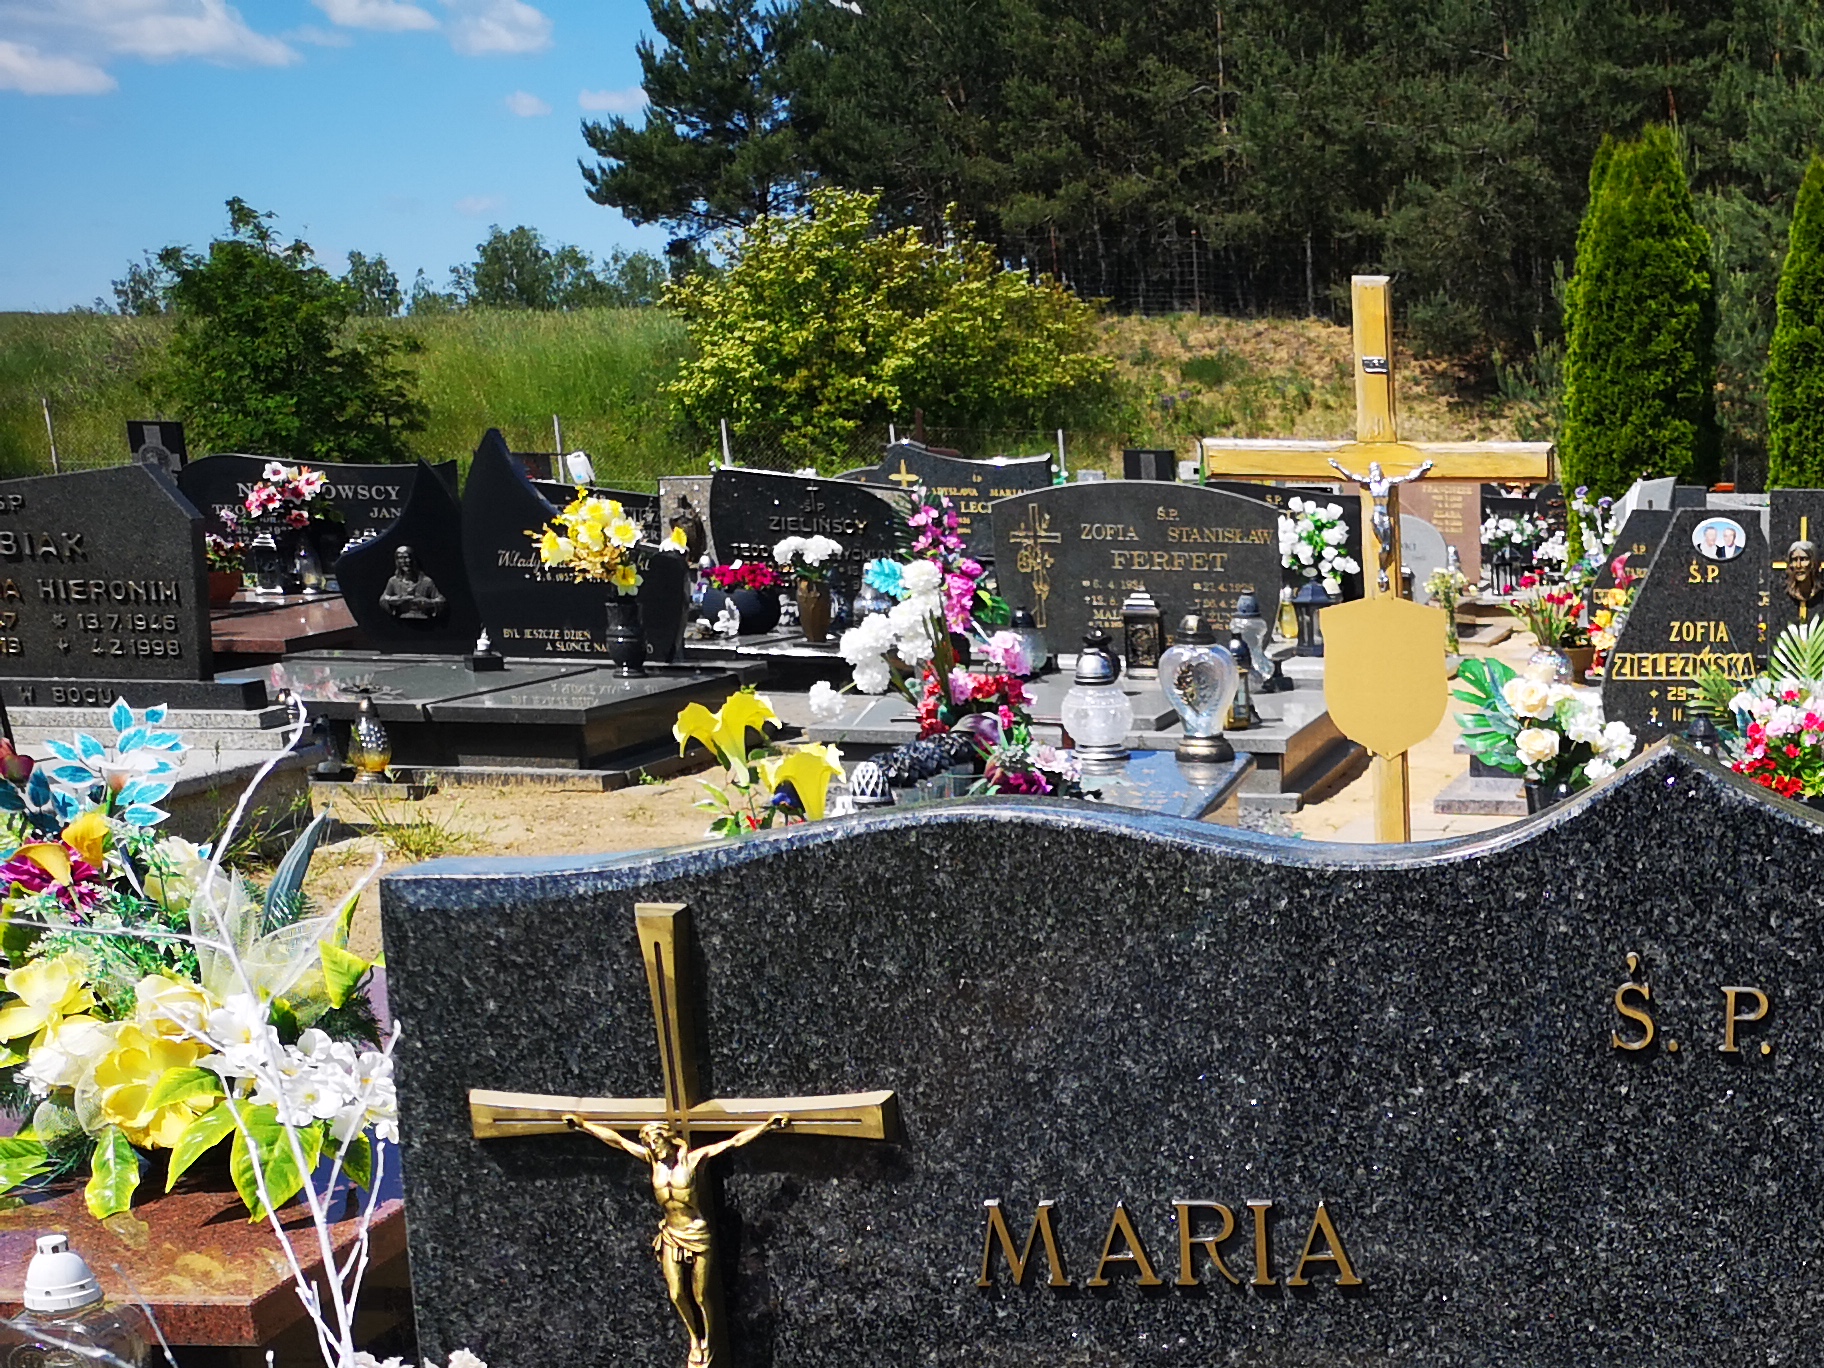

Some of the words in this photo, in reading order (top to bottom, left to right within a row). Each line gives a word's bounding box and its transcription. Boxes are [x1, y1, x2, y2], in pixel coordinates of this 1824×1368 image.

[369, 507, 402, 519] JAN
[1081, 523, 1140, 542] ZOFIA
[1167, 527, 1275, 545] STANISŁAW
[1110, 550, 1228, 572] FERFET
[1689, 560, 1720, 584] Ś.P.
[36, 578, 178, 602] HIERONIM
[1668, 621, 1729, 643] ZOFIA
[977, 1199, 1363, 1288] MARIA
